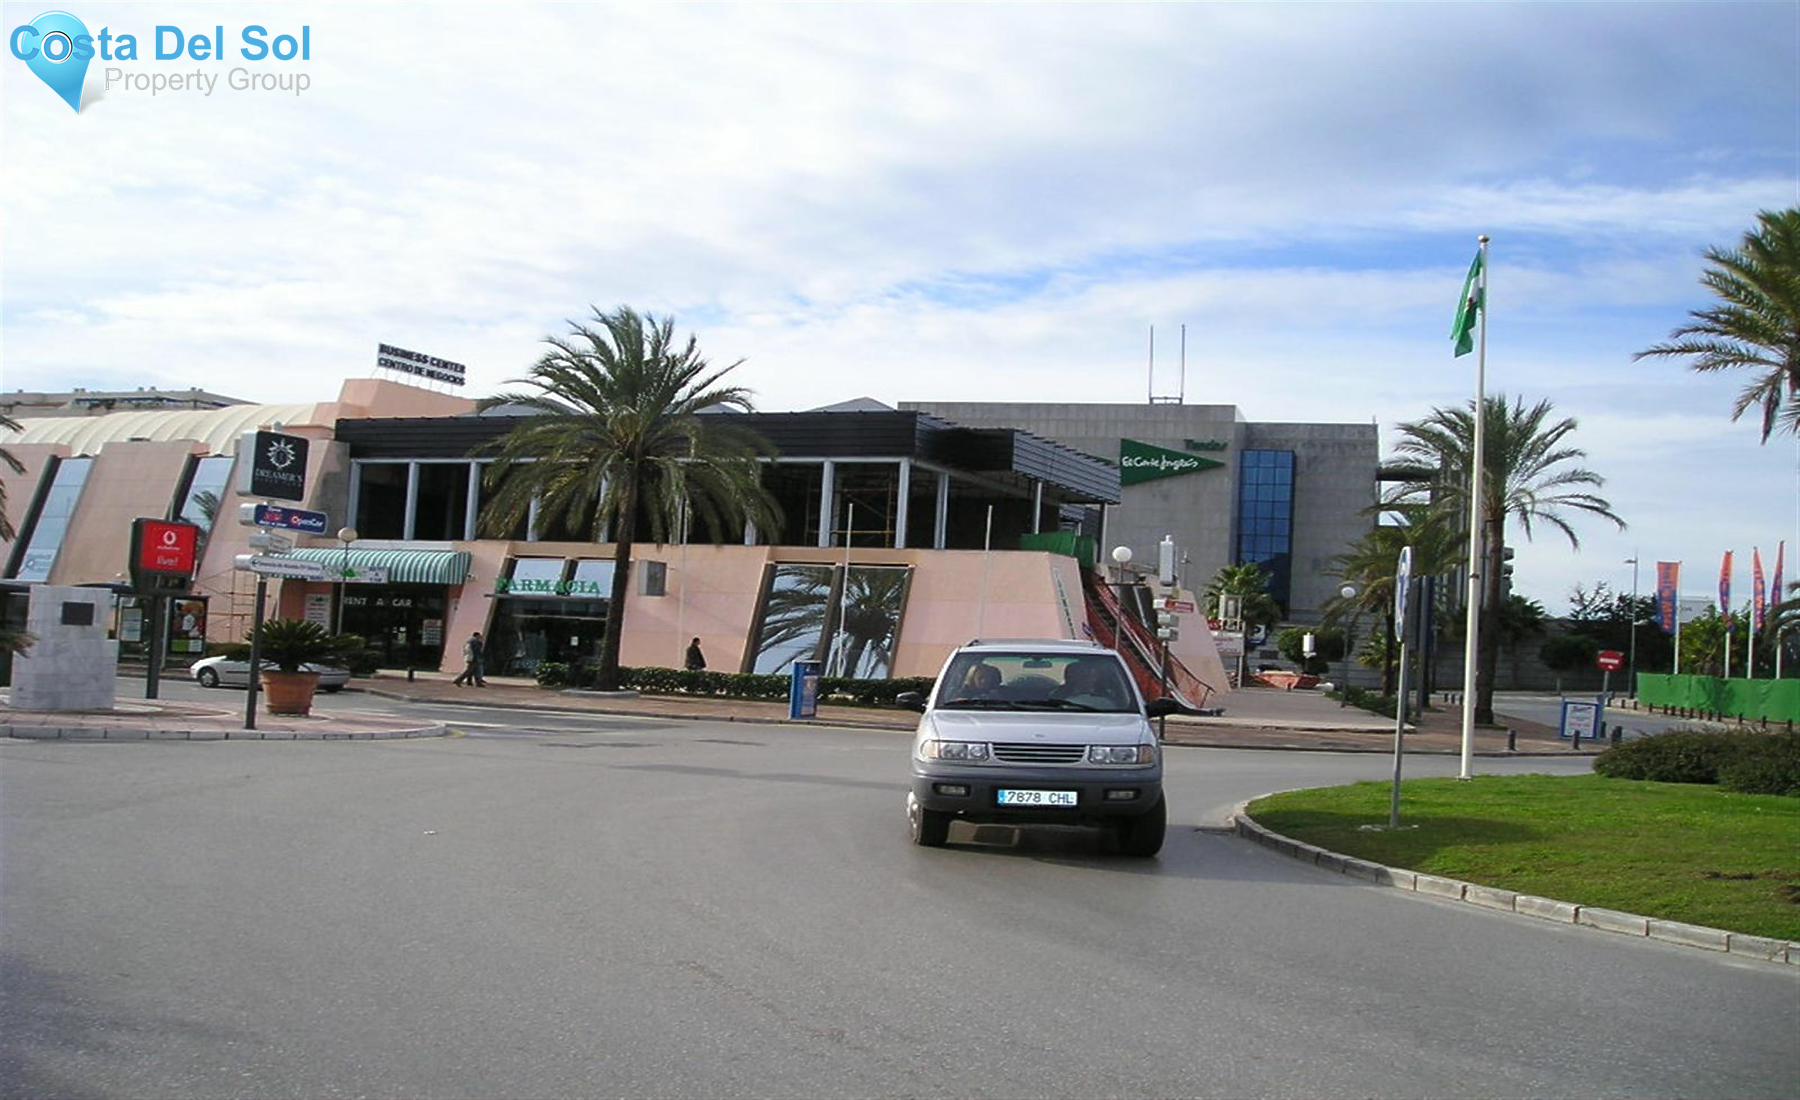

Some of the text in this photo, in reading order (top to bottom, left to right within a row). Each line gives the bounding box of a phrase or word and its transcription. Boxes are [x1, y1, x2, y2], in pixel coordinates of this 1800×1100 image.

[378, 358, 413, 373] CENTRO
[379, 343, 466, 374] BUSINESS CENTER
[495, 577, 601, 595] FARMACIA
[376, 598, 384, 606] A
[392, 598, 412, 607] CAR
[1048, 792, 1075, 804] CHL
